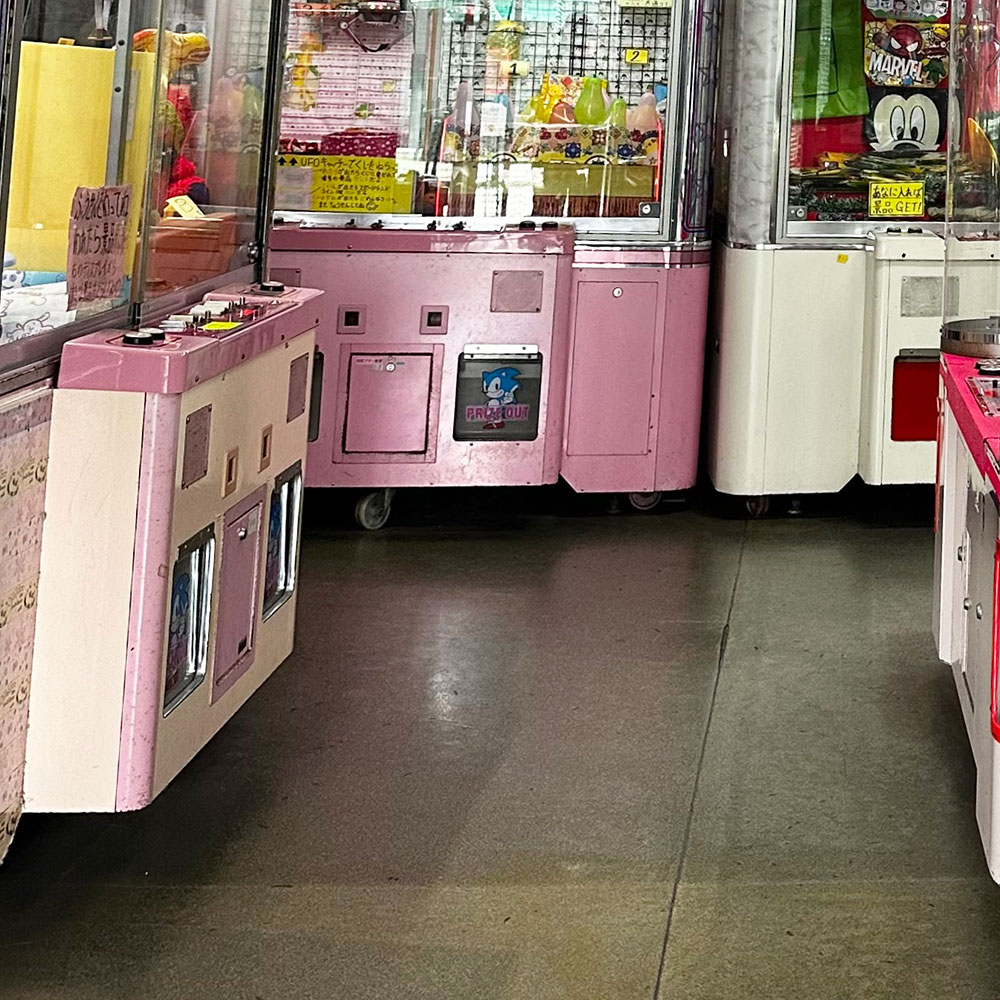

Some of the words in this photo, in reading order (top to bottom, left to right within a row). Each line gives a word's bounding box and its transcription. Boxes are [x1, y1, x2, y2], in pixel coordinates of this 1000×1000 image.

[630, 51, 640, 62] 2
[868, 52, 923, 82] MARVEL
[872, 185, 923, 199] あなに入れば
[467, 407, 501, 419] PRIZE
[506, 406, 530, 420] OUT
